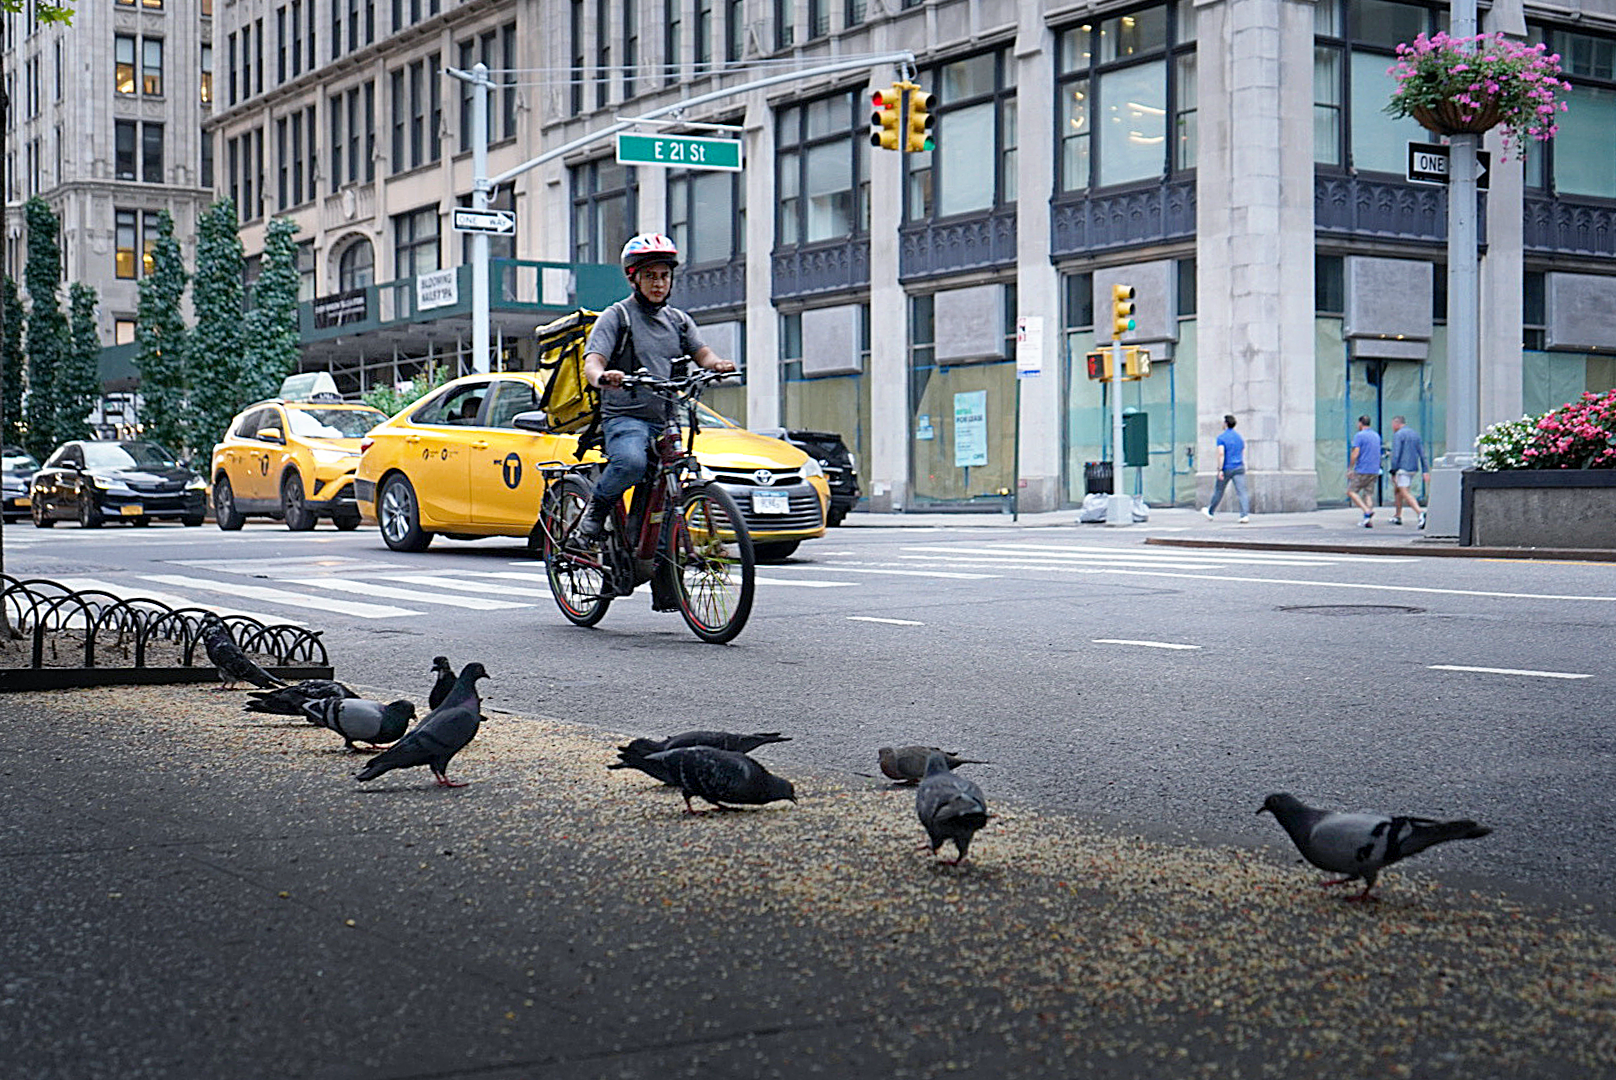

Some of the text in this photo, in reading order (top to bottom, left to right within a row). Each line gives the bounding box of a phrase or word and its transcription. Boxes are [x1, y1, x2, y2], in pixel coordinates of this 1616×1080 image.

[654, 141, 705, 161] E 21 St
[1420, 155, 1445, 172] ONE
[459, 216, 477, 225] ONE
